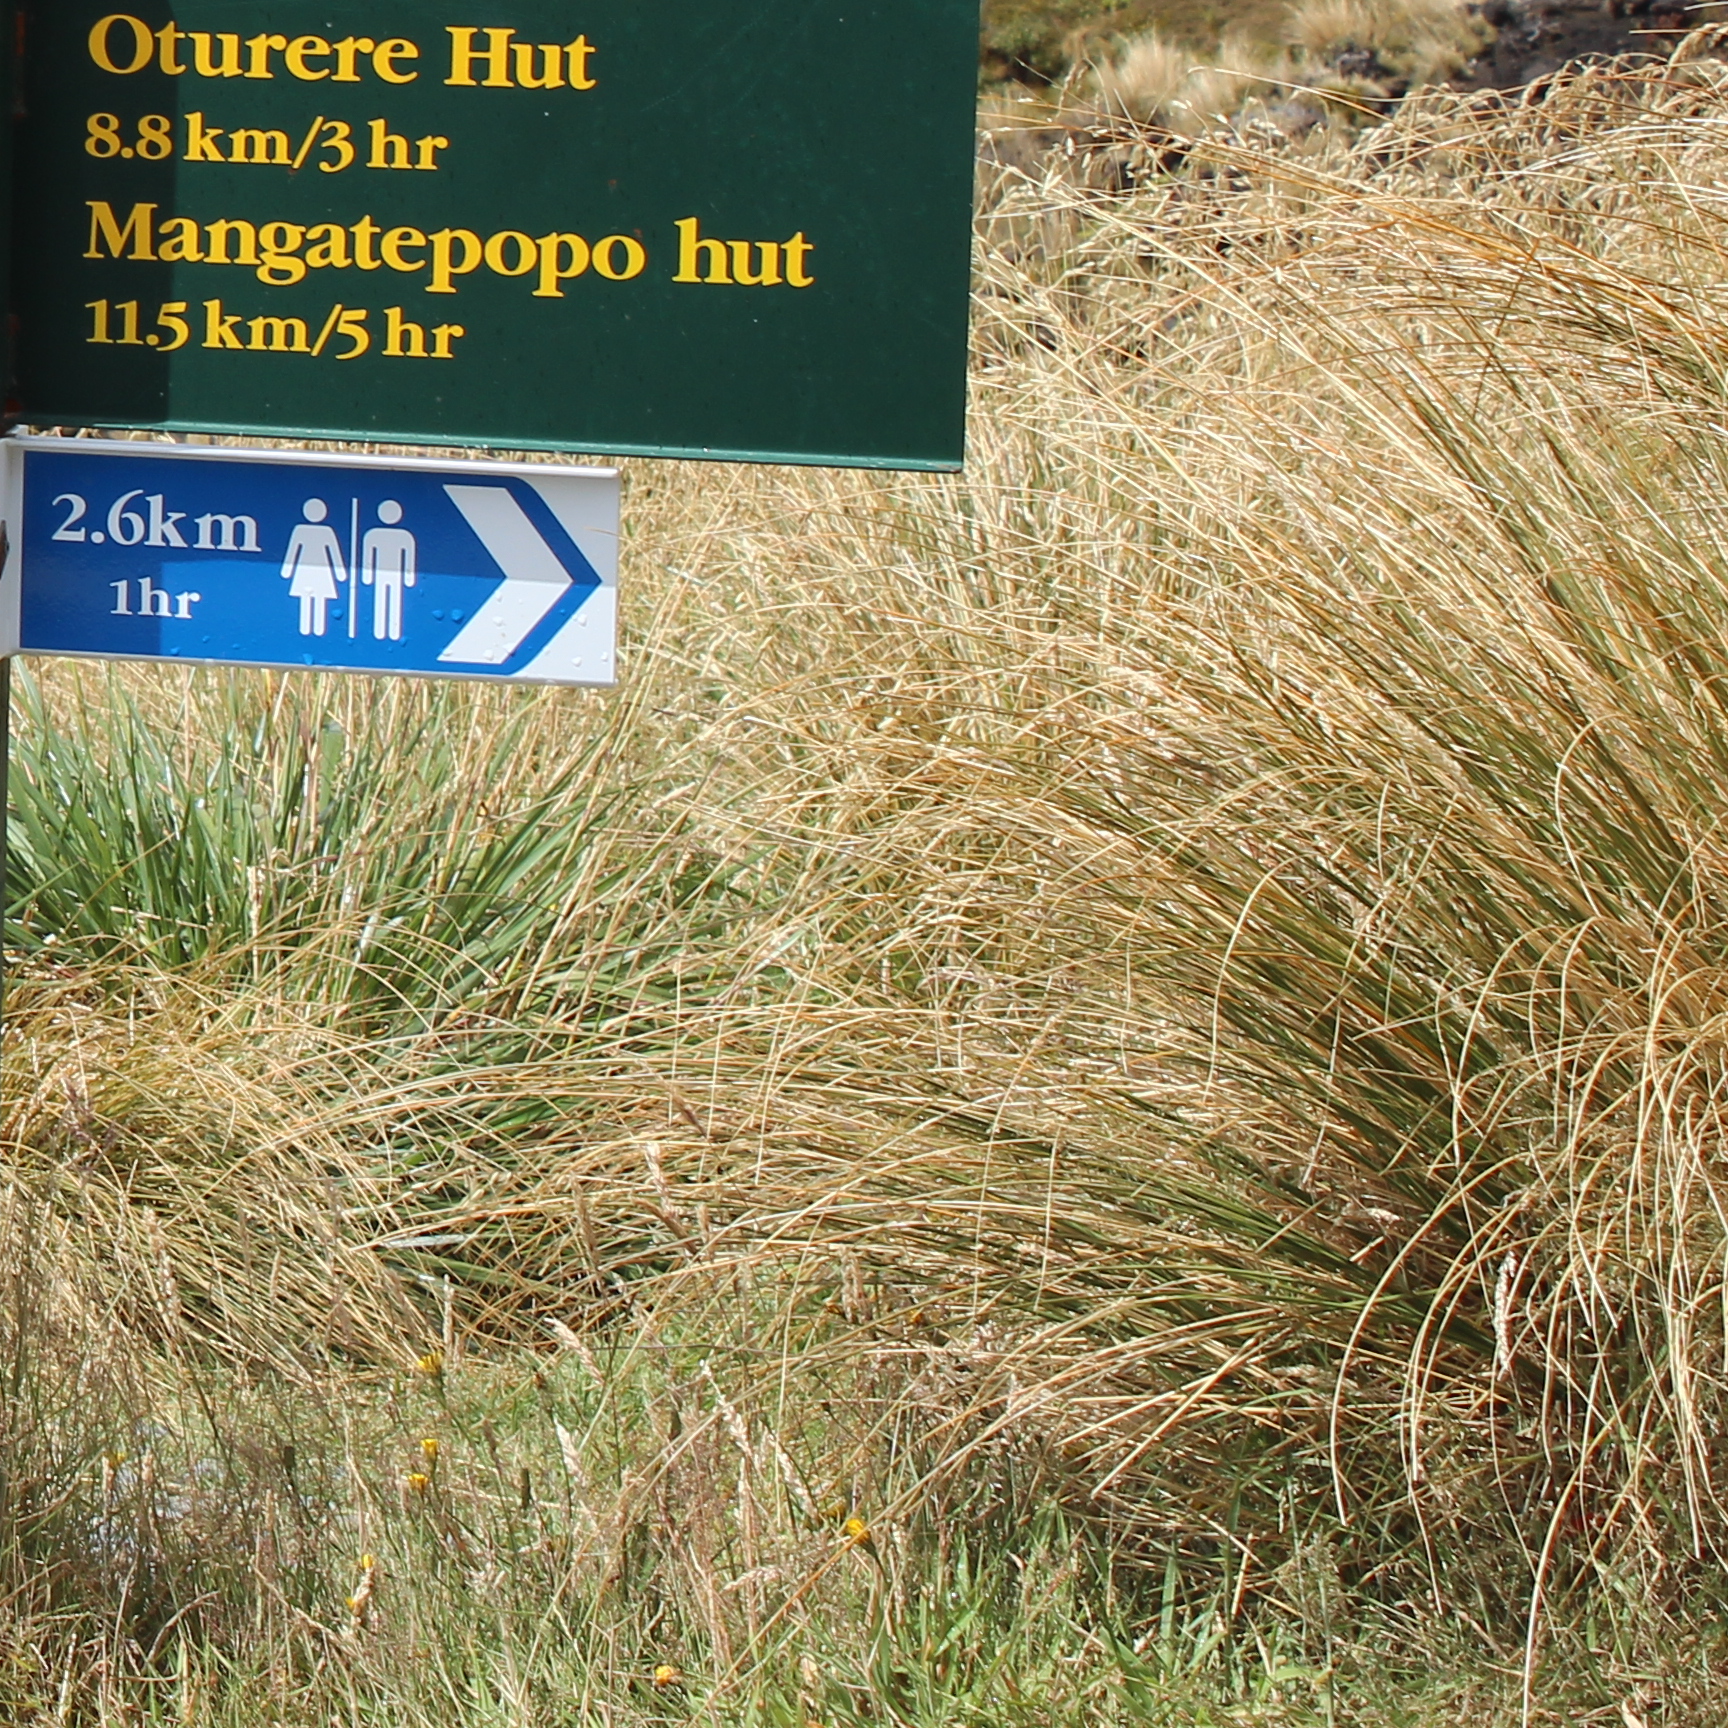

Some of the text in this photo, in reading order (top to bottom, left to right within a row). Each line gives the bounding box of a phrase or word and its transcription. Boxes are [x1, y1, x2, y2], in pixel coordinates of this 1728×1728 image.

[88, 13, 599, 91] Oturere Hut
[83, 200, 815, 298] Mangatepopo hut
[51, 489, 263, 553] 2.6km
[109, 576, 202, 620] 1hr
